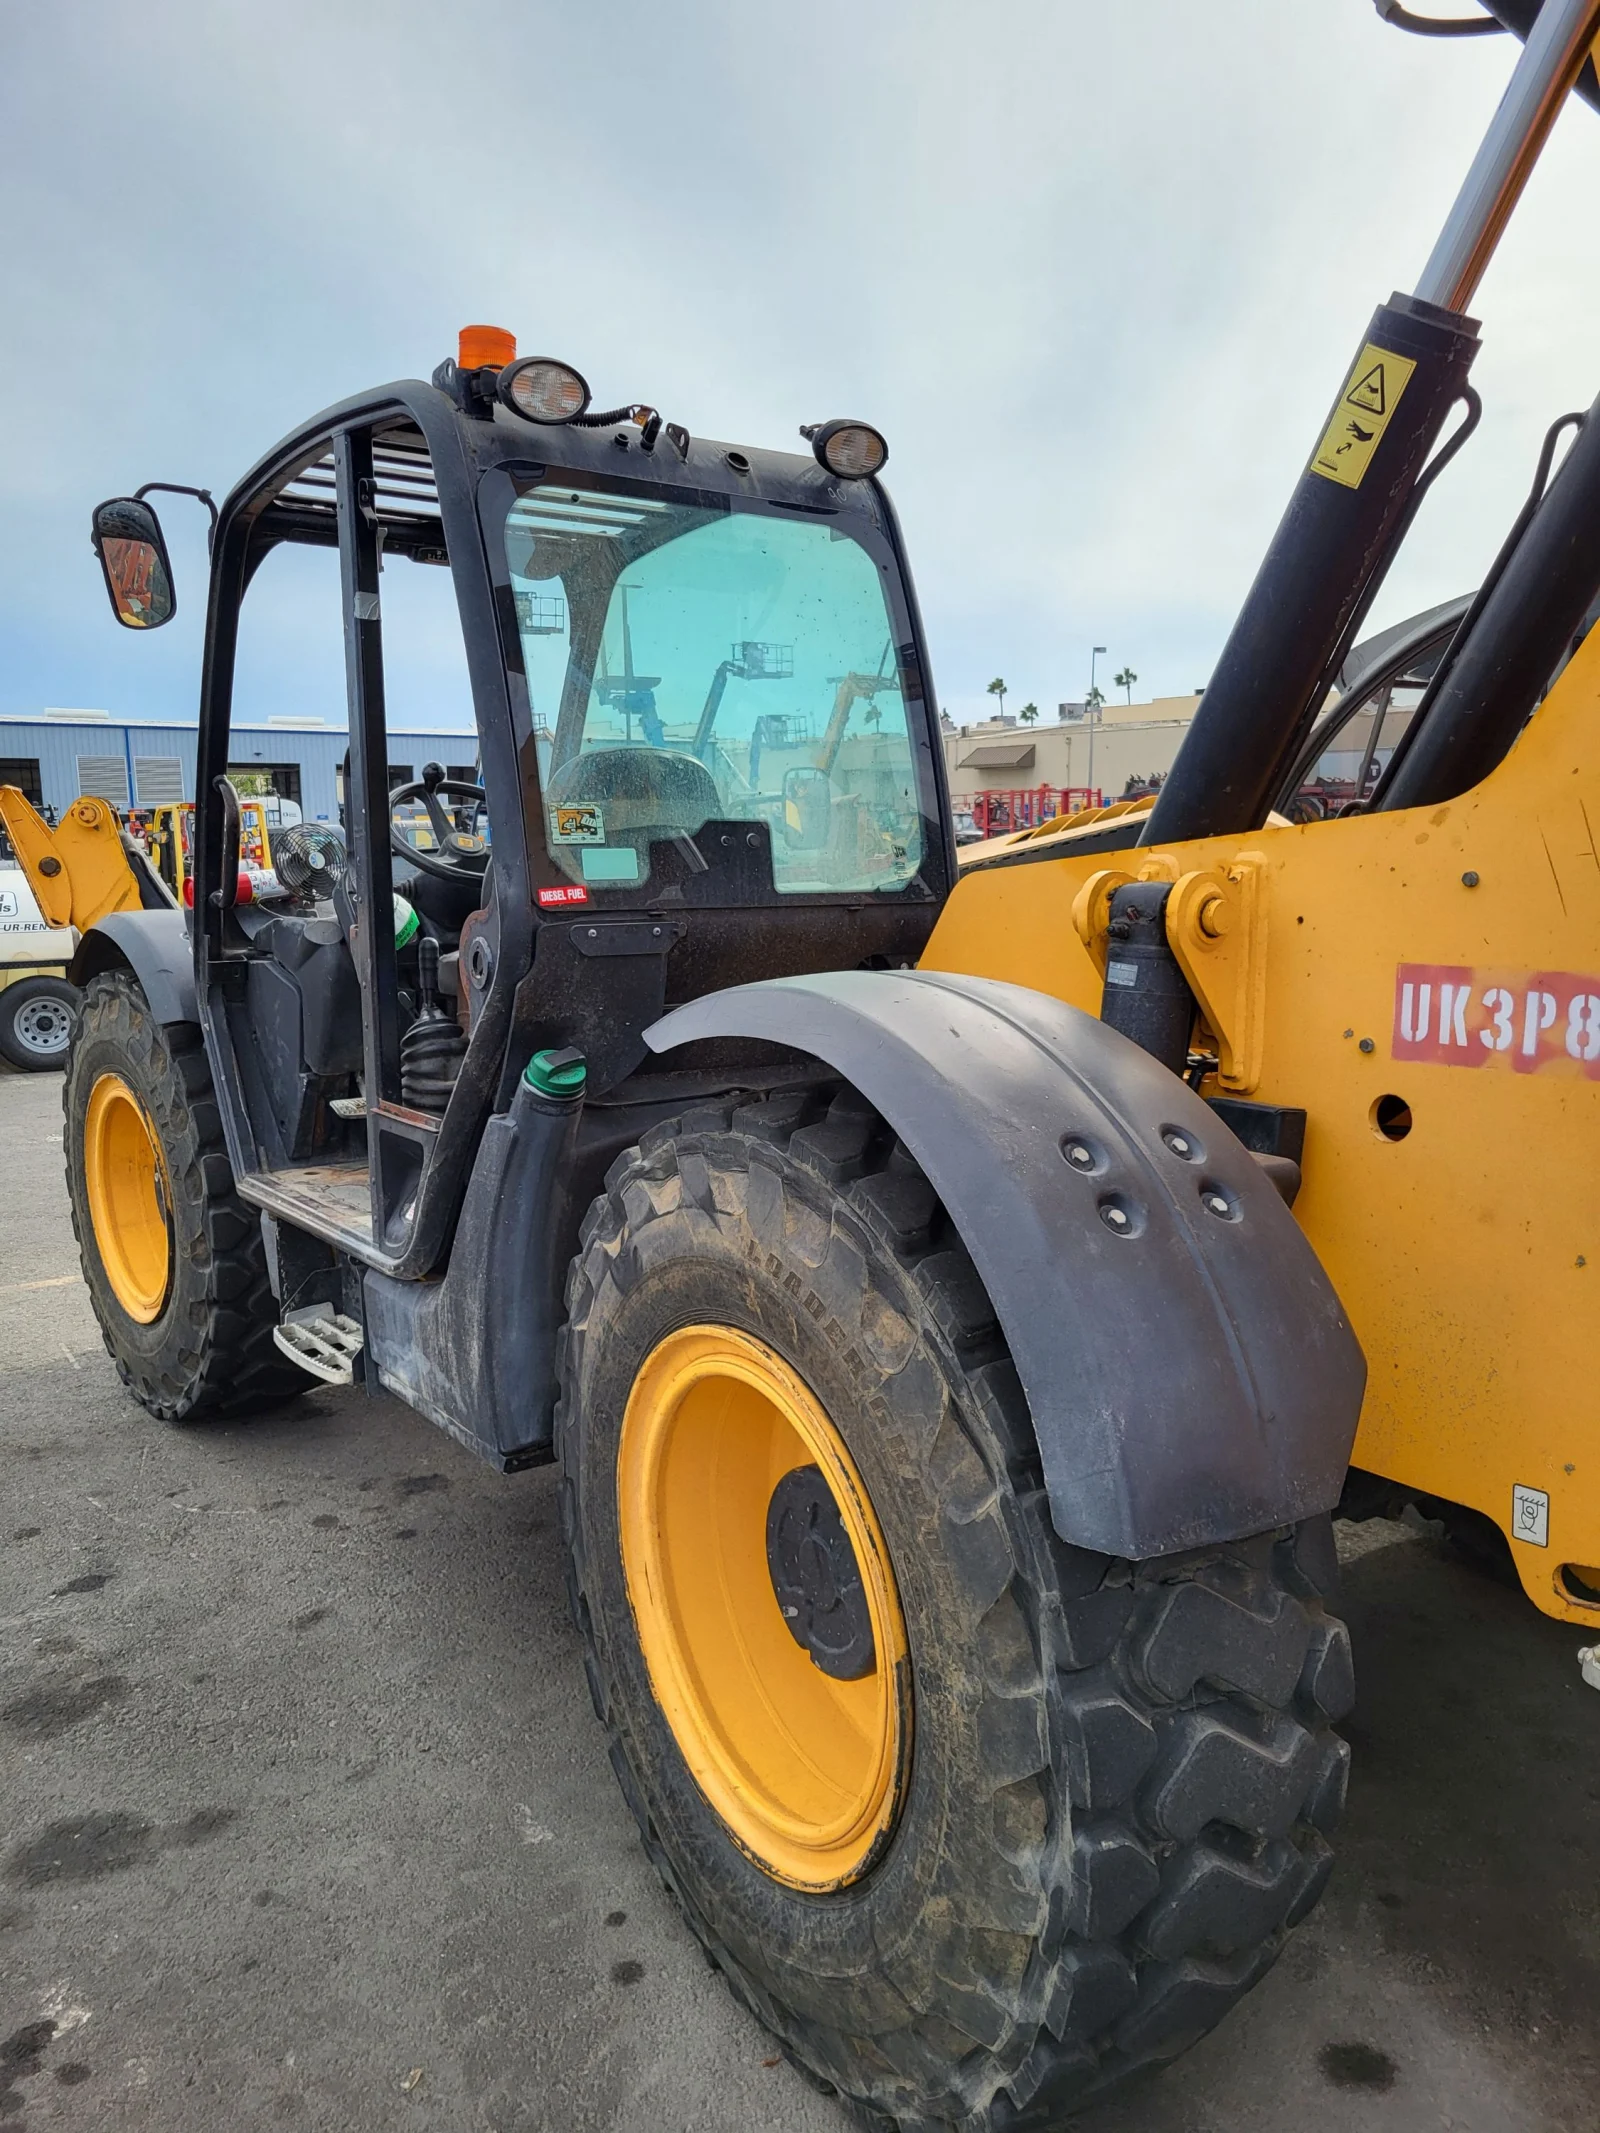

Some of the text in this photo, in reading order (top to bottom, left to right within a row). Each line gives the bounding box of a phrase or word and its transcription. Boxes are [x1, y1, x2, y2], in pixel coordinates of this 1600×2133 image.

[540, 888, 586, 903] DIESEL FUEL
[1399, 982, 1600, 1061] UK3P8
[746, 1239, 867, 1381] LOADER
